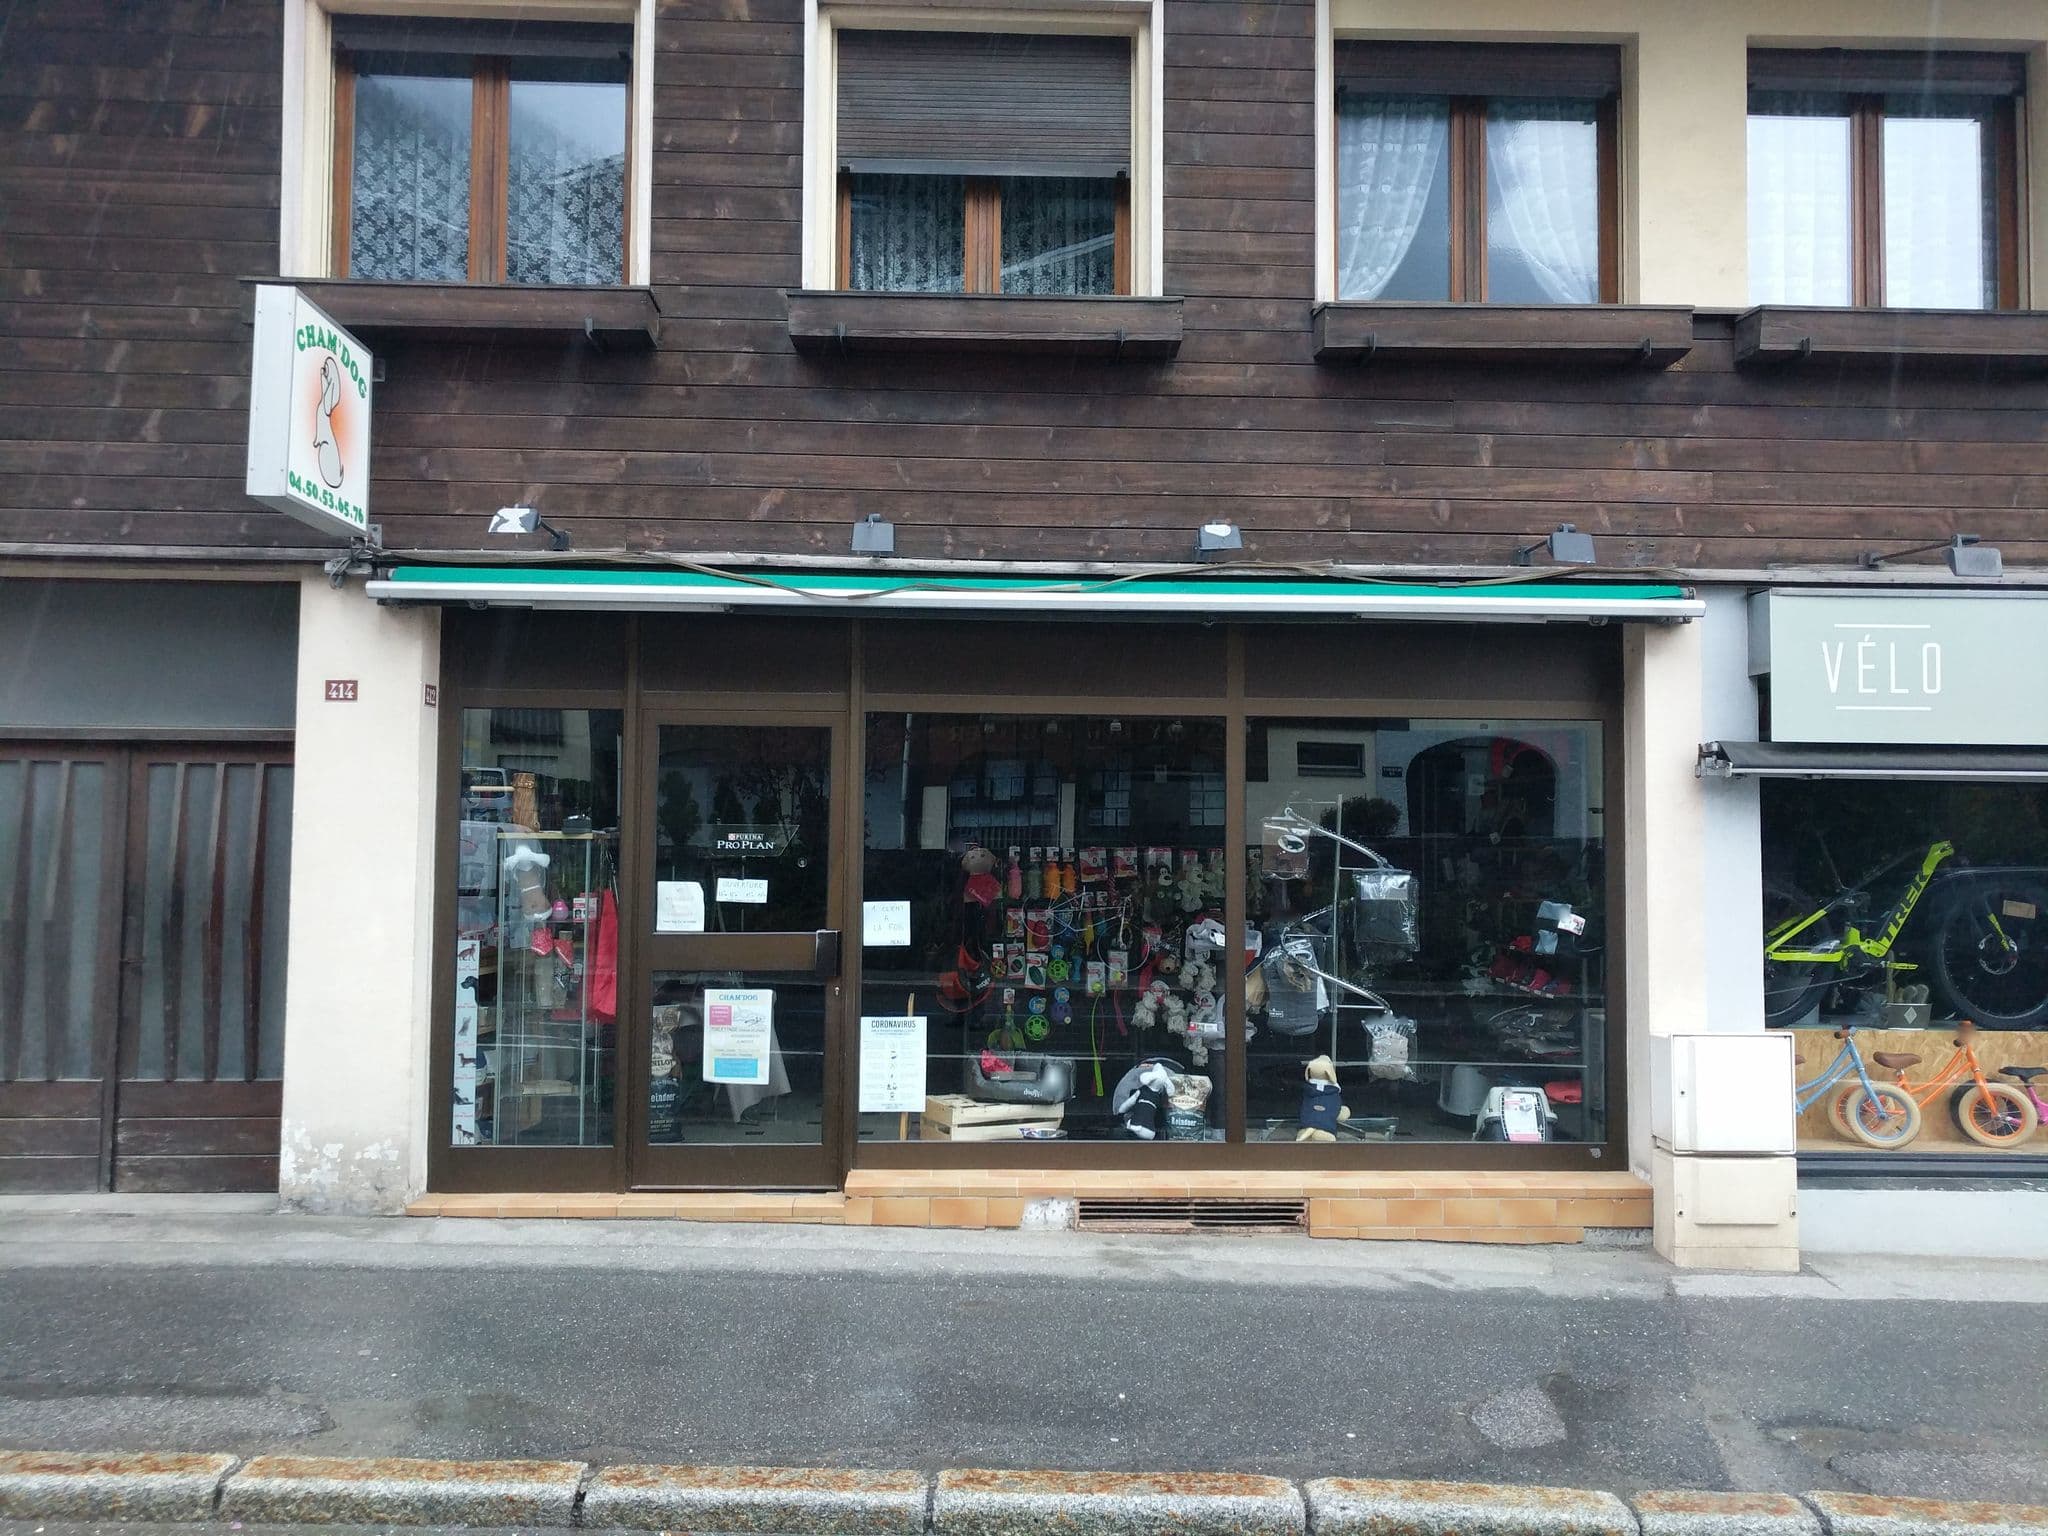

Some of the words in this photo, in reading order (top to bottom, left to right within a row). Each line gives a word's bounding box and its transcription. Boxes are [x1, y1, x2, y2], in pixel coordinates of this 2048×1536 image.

[297, 325, 367, 399] CHAM'DOG
[289, 470, 364, 524] 04.50.53.65.76
[1822, 634, 1942, 695] VÉLO
[328, 683, 355, 699] 414
[717, 840, 740, 849] PRO
[741, 840, 775, 850] PLAN
[736, 833, 763, 841] PURINA
[1879, 871, 1929, 946] TREK
[871, 1020, 917, 1028] CORONAVIRUS
